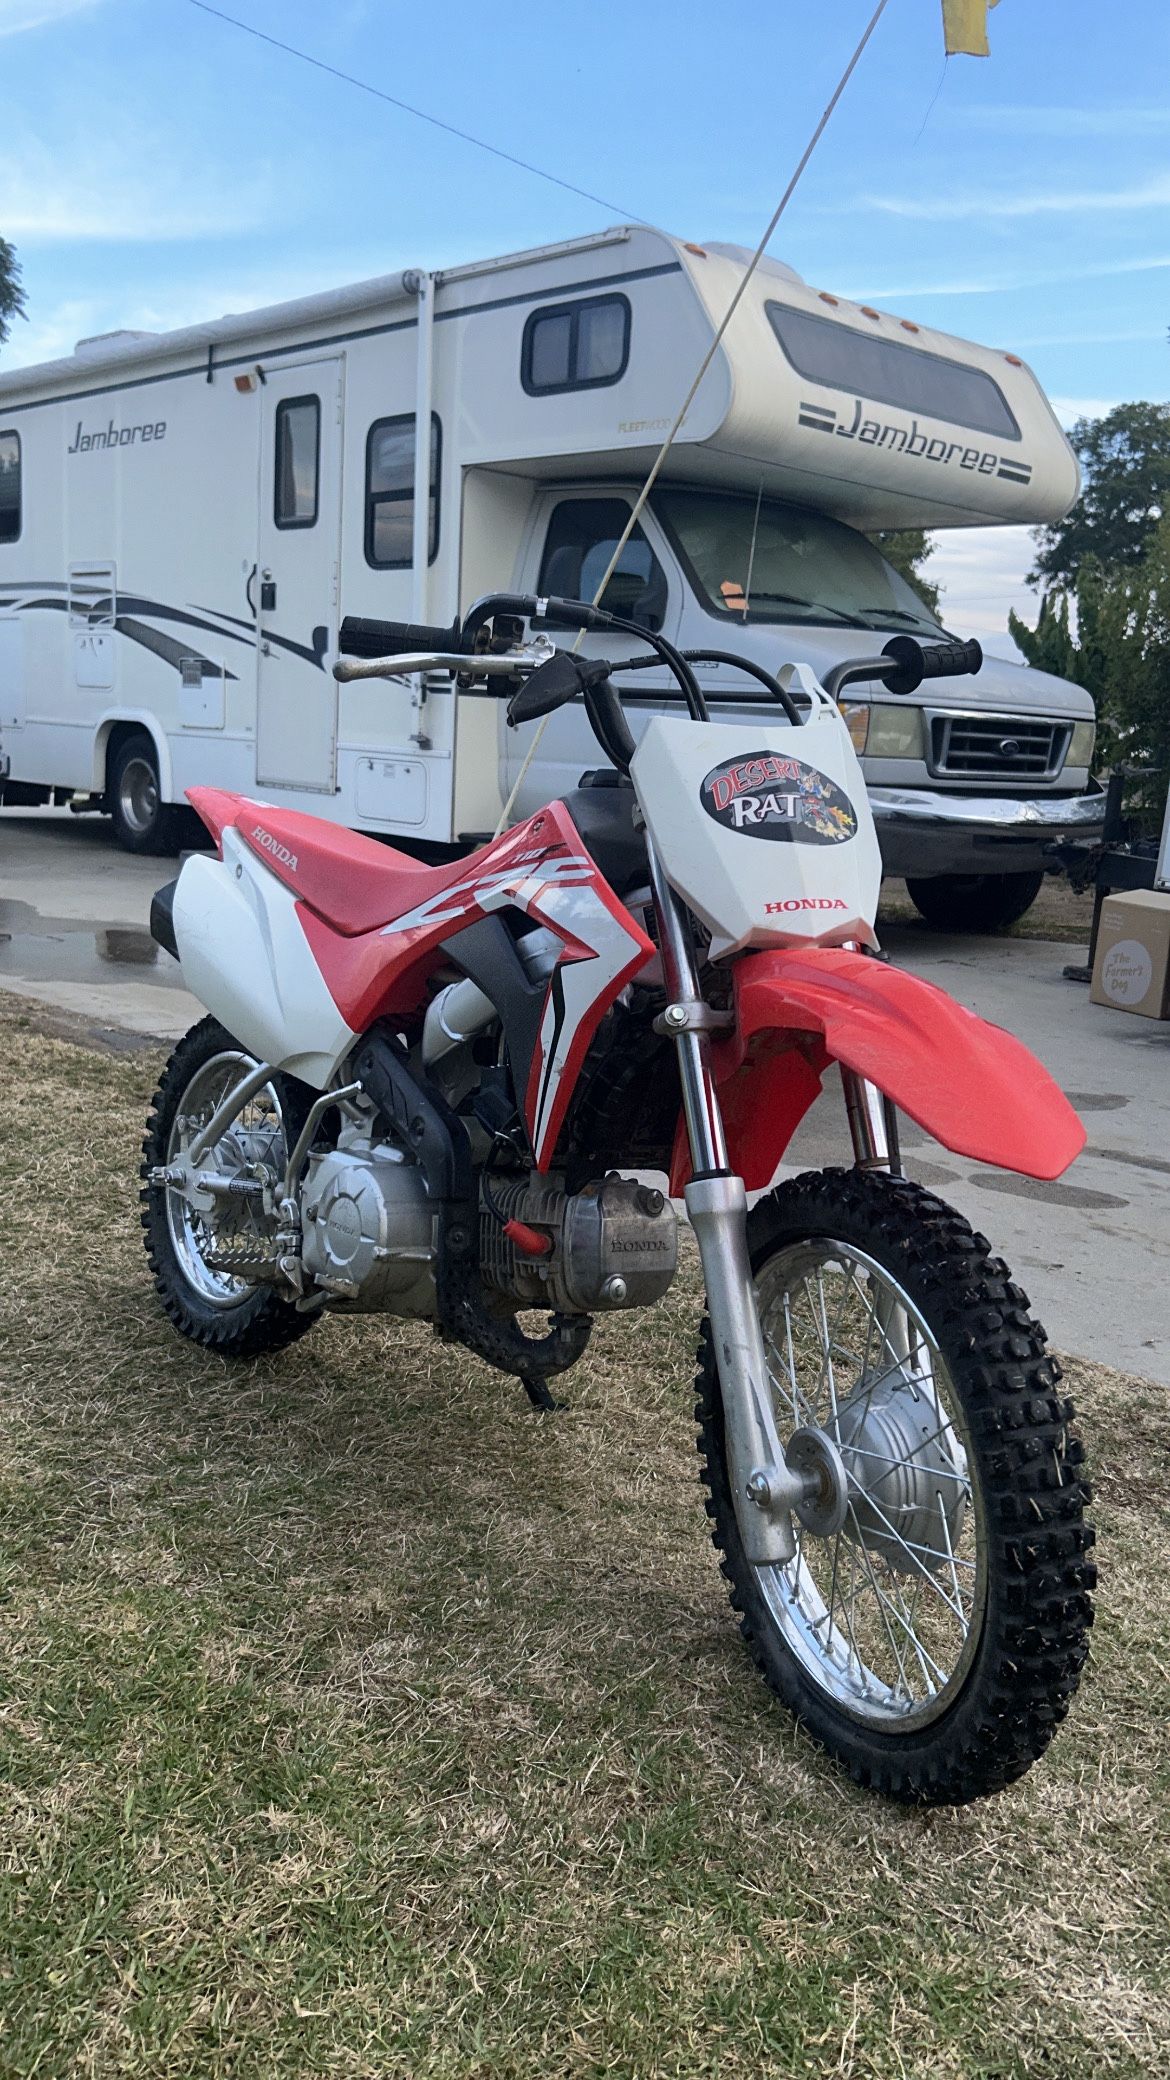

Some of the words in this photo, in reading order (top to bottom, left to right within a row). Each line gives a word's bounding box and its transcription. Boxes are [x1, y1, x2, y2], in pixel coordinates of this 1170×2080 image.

[68, 420, 167, 454] Jamboree
[836, 400, 998, 475] Jamboree
[709, 757, 802, 811] DESERT
[729, 793, 802, 828] RAT
[251, 825, 299, 872] HONDA
[764, 898, 849, 915] HONDA
[1112, 952, 1131, 964] The
[1111, 979, 1128, 994] Dog
[611, 1240, 671, 1253] HONDA
